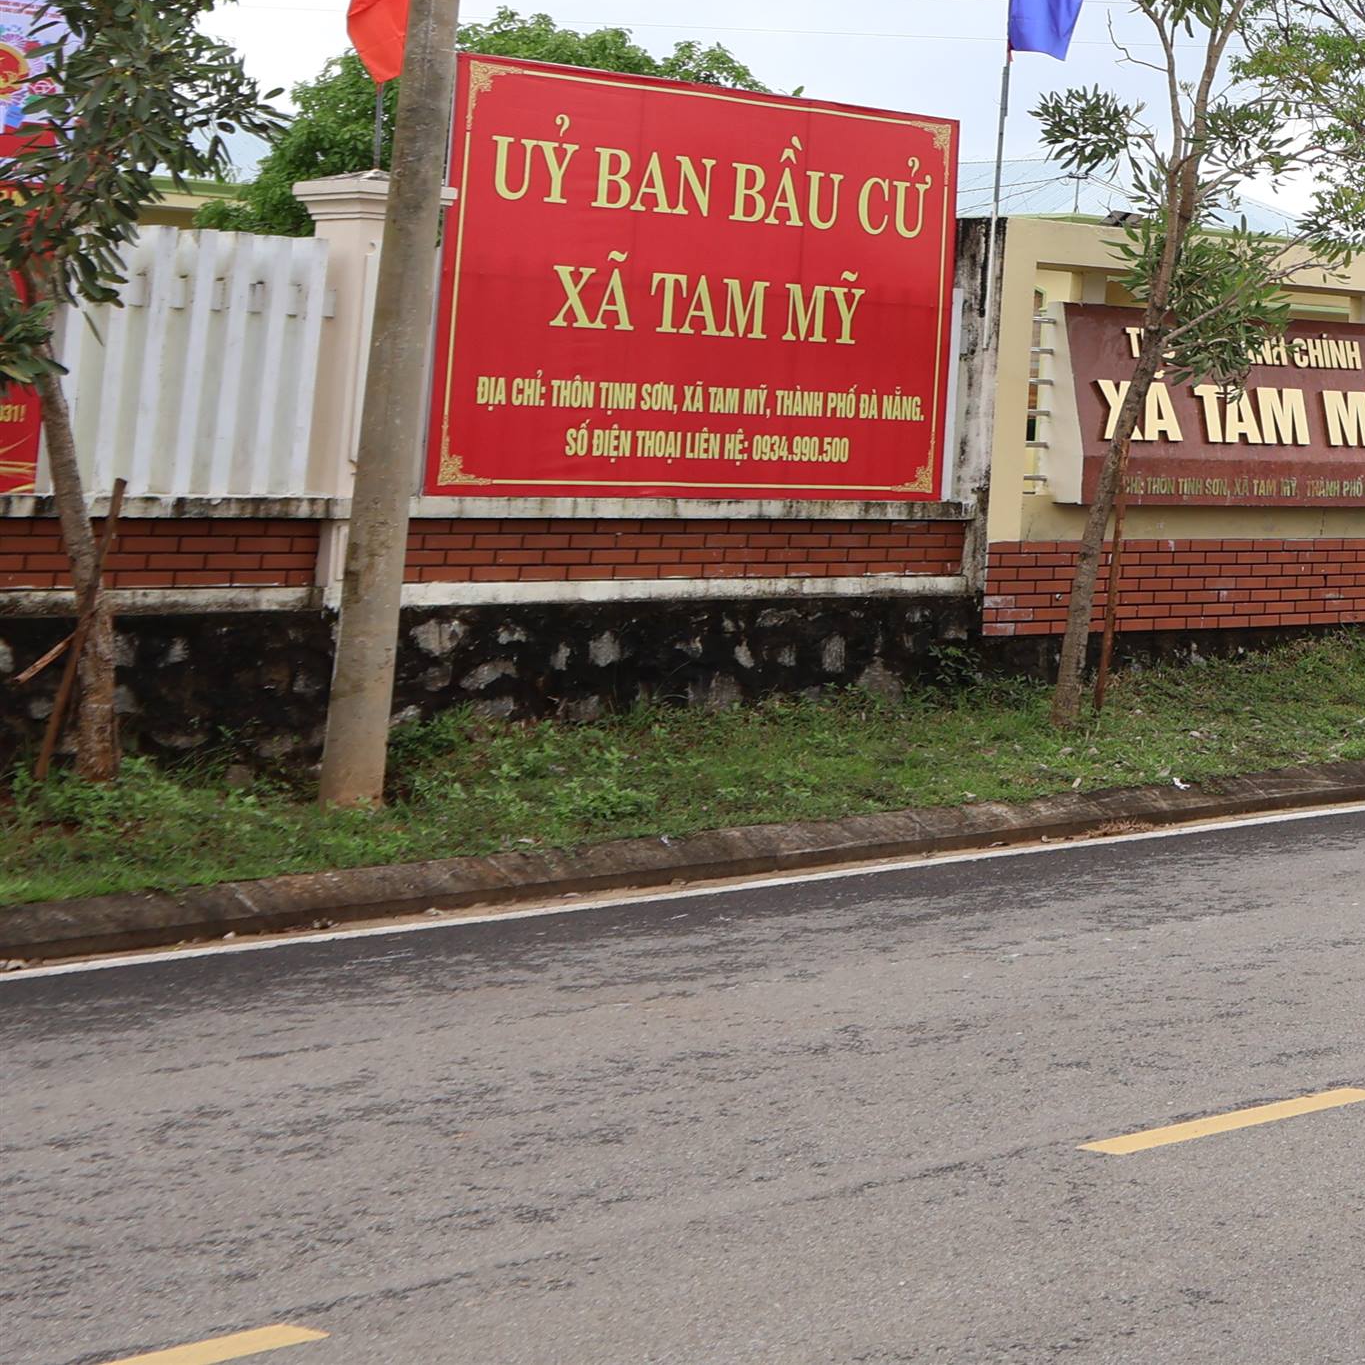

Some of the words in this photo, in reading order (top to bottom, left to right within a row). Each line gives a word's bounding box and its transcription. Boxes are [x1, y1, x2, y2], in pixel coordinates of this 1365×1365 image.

[491, 114, 580, 205] UỶ
[591, 146, 716, 218] BAN
[728, 135, 844, 230] BẦU
[857, 157, 932, 238] CỬ
[549, 250, 634, 331] XÃ
[650, 272, 770, 339] TAM
[782, 271, 866, 345] MỸ
[476, 376, 507, 411] ĐỊA
[511, 370, 546, 407] CHỈ:
[551, 375, 595, 408] THÔN
[599, 381, 636, 415] TỊNH
[640, 381, 678, 414] SƠN,
[682, 381, 704, 412] XÃ
[708, 386, 740, 414] TAM
[743, 384, 771, 418] MỸ,
[776, 385, 824, 417] THÀNH
[826, 384, 858, 418] PHỐ
[858, 389, 878, 419] ĐÀ
[1194, 385, 1310, 445] TAM
[565, 419, 590, 456] SỐ
[592, 424, 632, 463] ĐIỆN
[636, 431, 681, 464] THOẠI
[685, 427, 721, 459] LIÊN
[724, 428, 748, 466] HỆ:
[752, 434, 850, 463] 0934.990.500
